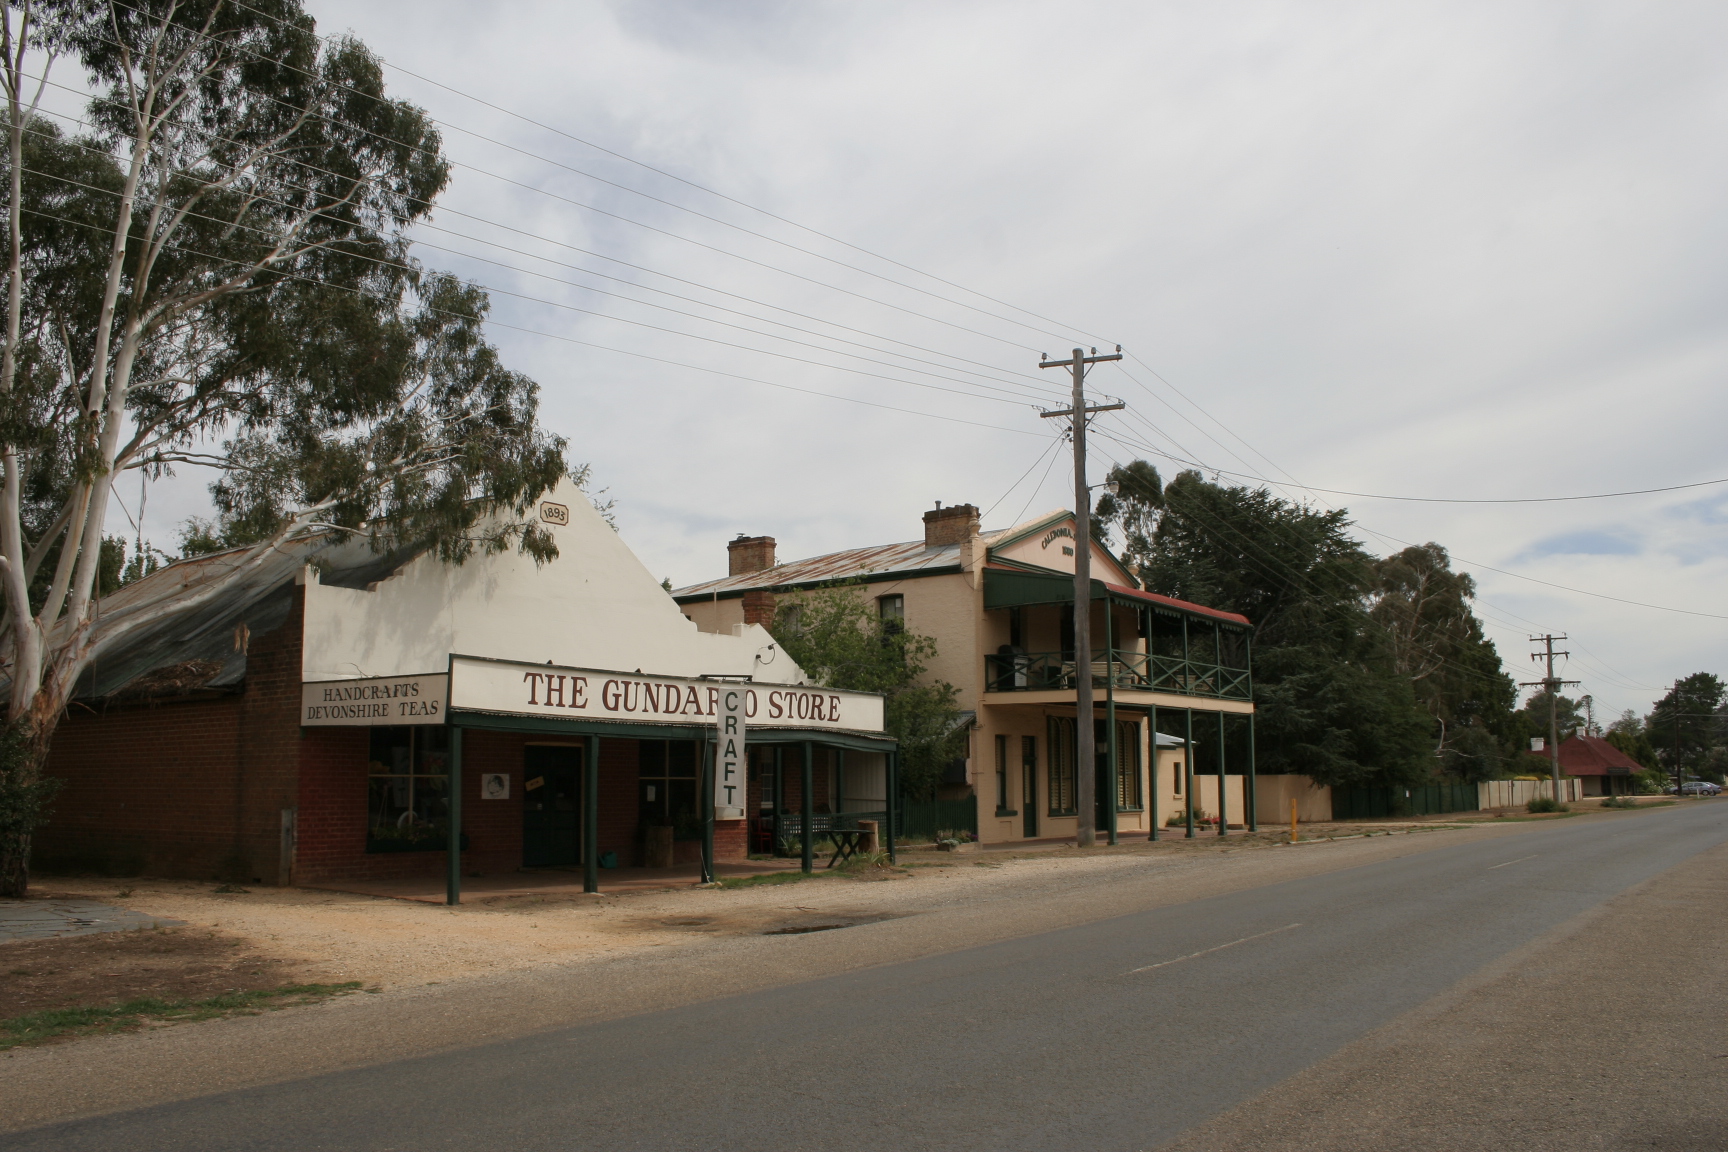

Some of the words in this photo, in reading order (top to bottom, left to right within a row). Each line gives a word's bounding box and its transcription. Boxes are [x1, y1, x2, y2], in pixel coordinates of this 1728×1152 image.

[544, 507, 566, 521] 1893
[323, 682, 420, 702] HANDCRAFTS
[523, 672, 588, 709] THE
[602, 680, 758, 718] GUNDARO
[769, 691, 841, 722] STORE
[307, 703, 389, 720] DEVONSHIRE
[399, 700, 439, 716] TEAS
[724, 691, 738, 805] CRAFT
